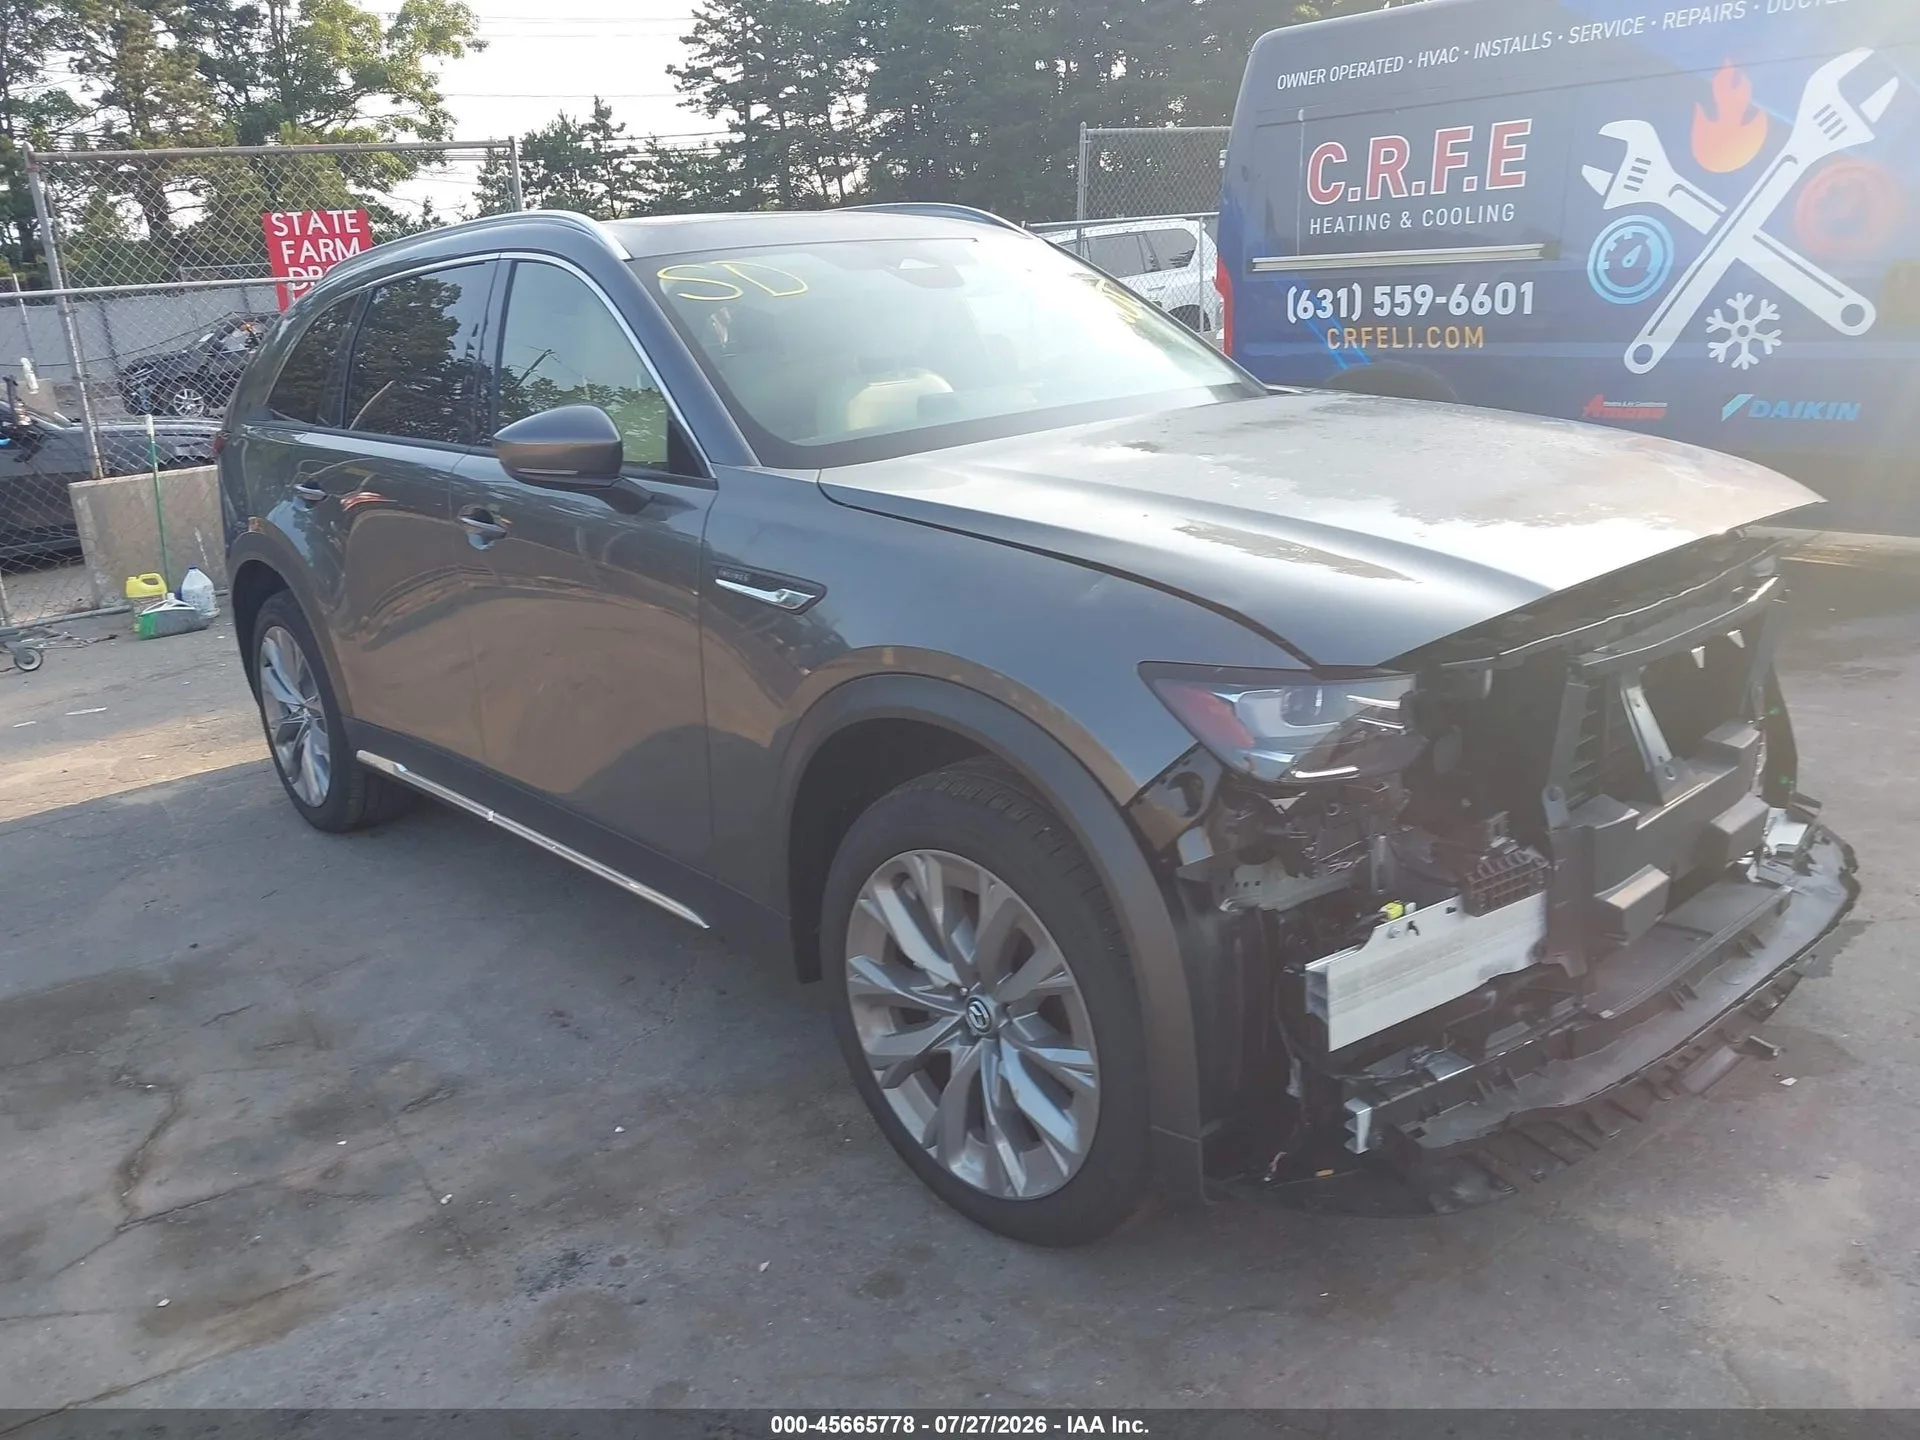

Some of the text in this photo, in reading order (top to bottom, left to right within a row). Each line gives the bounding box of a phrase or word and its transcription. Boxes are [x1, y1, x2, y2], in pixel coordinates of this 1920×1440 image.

[1277, 68, 1326, 90] OWNER
[1329, 55, 1404, 82] OPERATED
[1417, 46, 1460, 68] HVAC
[1473, 31, 1552, 59] INSTALLS
[1568, 16, 1646, 44] SERVICE
[1662, 0, 1746, 30] REPAIRS
[1307, 118, 1533, 205] C.R.F.E
[271, 209, 361, 237] STATE
[1309, 203, 1515, 235] HEATING & COOLING
[281, 237, 361, 265] FARM
[1287, 281, 1534, 324] (631) 559-6601
[1327, 326, 1484, 350] CRFELI.COM
[1748, 400, 1861, 421] DAIKIN
